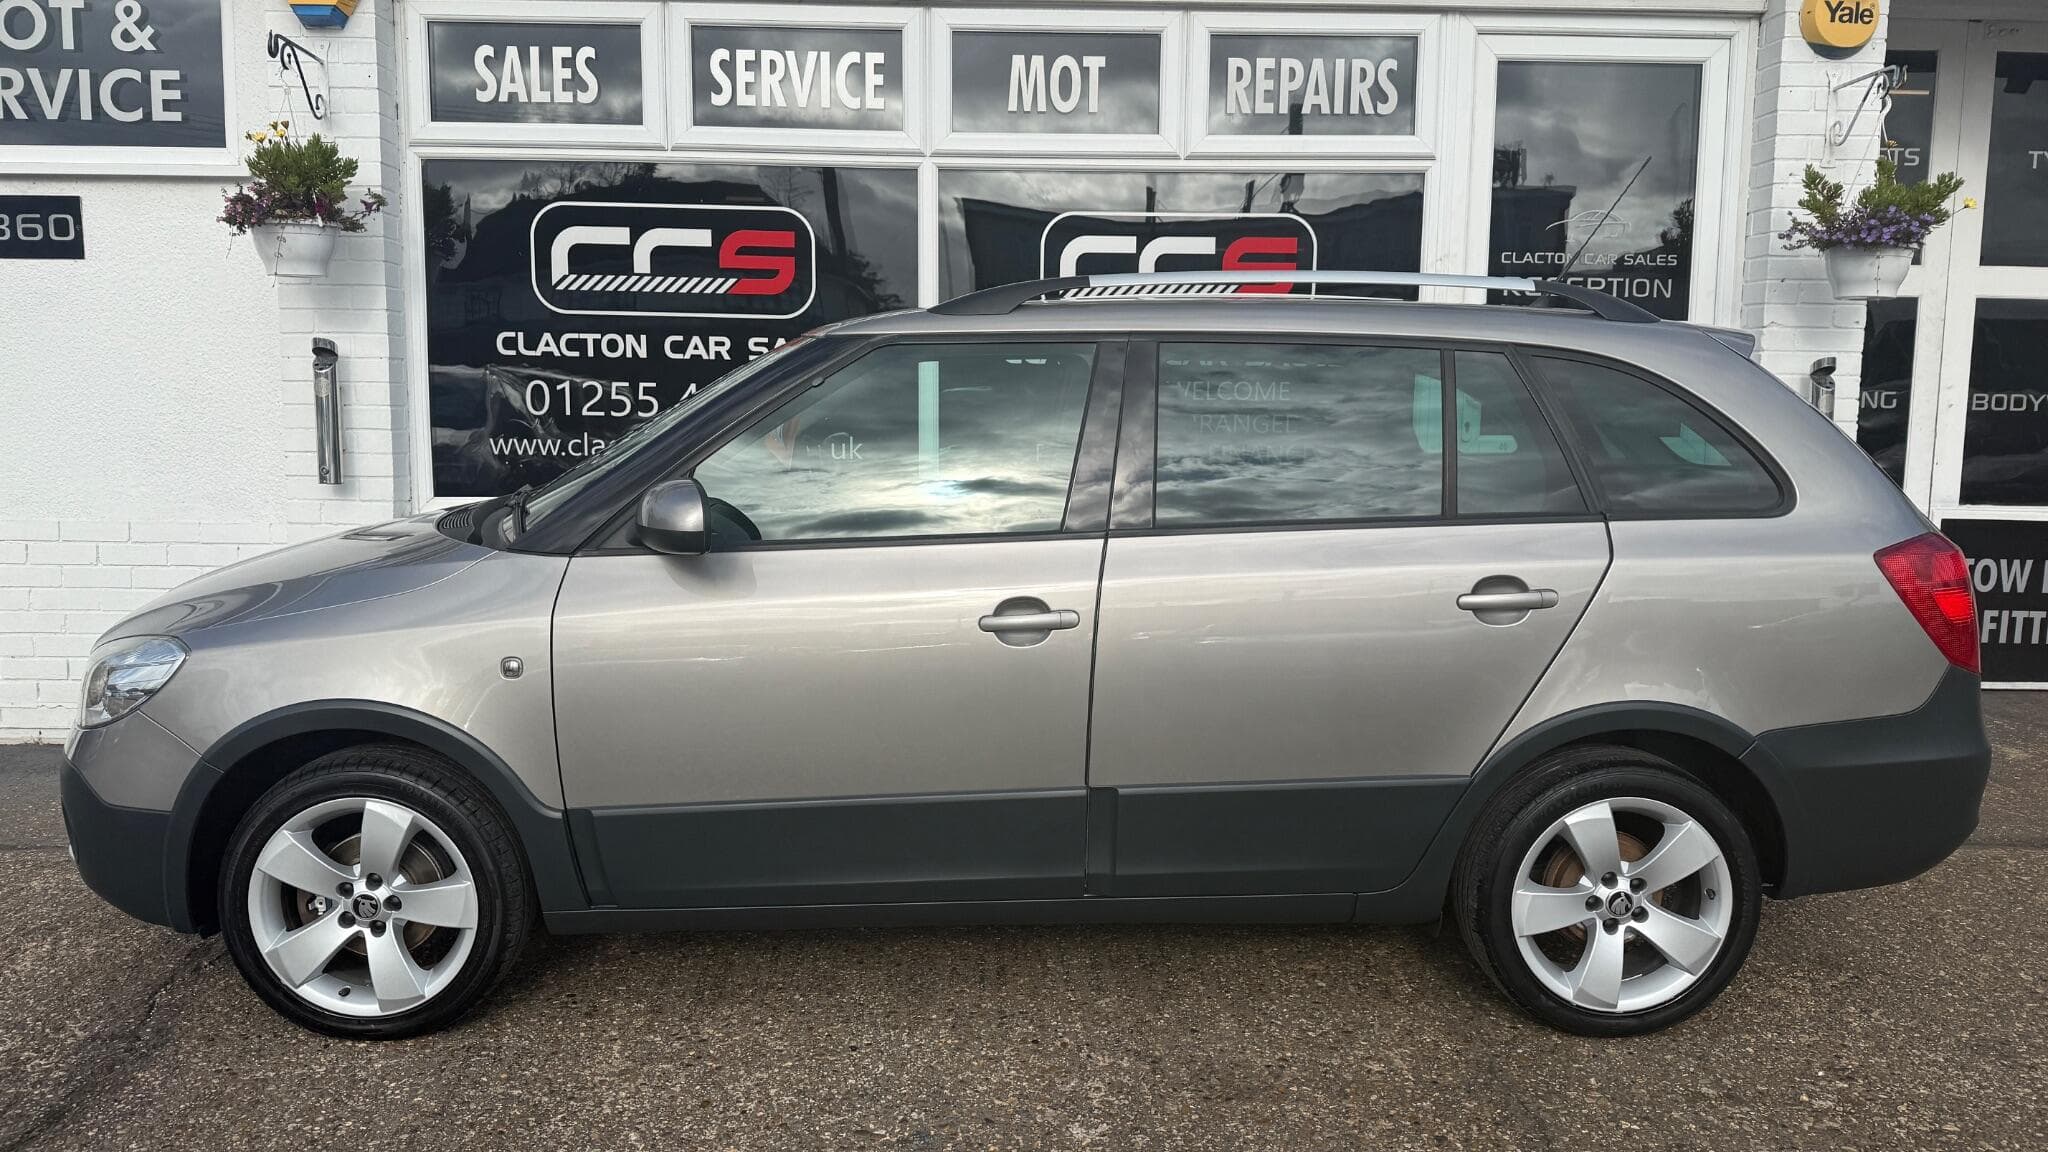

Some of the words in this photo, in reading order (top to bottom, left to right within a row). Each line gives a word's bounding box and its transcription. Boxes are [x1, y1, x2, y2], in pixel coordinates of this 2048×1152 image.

[110, 0, 157, 51] &
[1824, 0, 1874, 25] Yale
[0, 67, 183, 122] RVICE
[474, 44, 599, 104] SALES
[709, 48, 886, 110] SERVICE
[1007, 54, 1107, 113] MOT
[1225, 57, 1399, 115] REPAIRS
[1501, 251, 1577, 265] CLACTON
[1584, 253, 1617, 265] CAR
[1623, 254, 1678, 266] SALES
[496, 331, 648, 359] CLACTON
[664, 335, 732, 360] CAR
[525, 379, 660, 418] 01255
[1981, 609, 2048, 645] FITT
